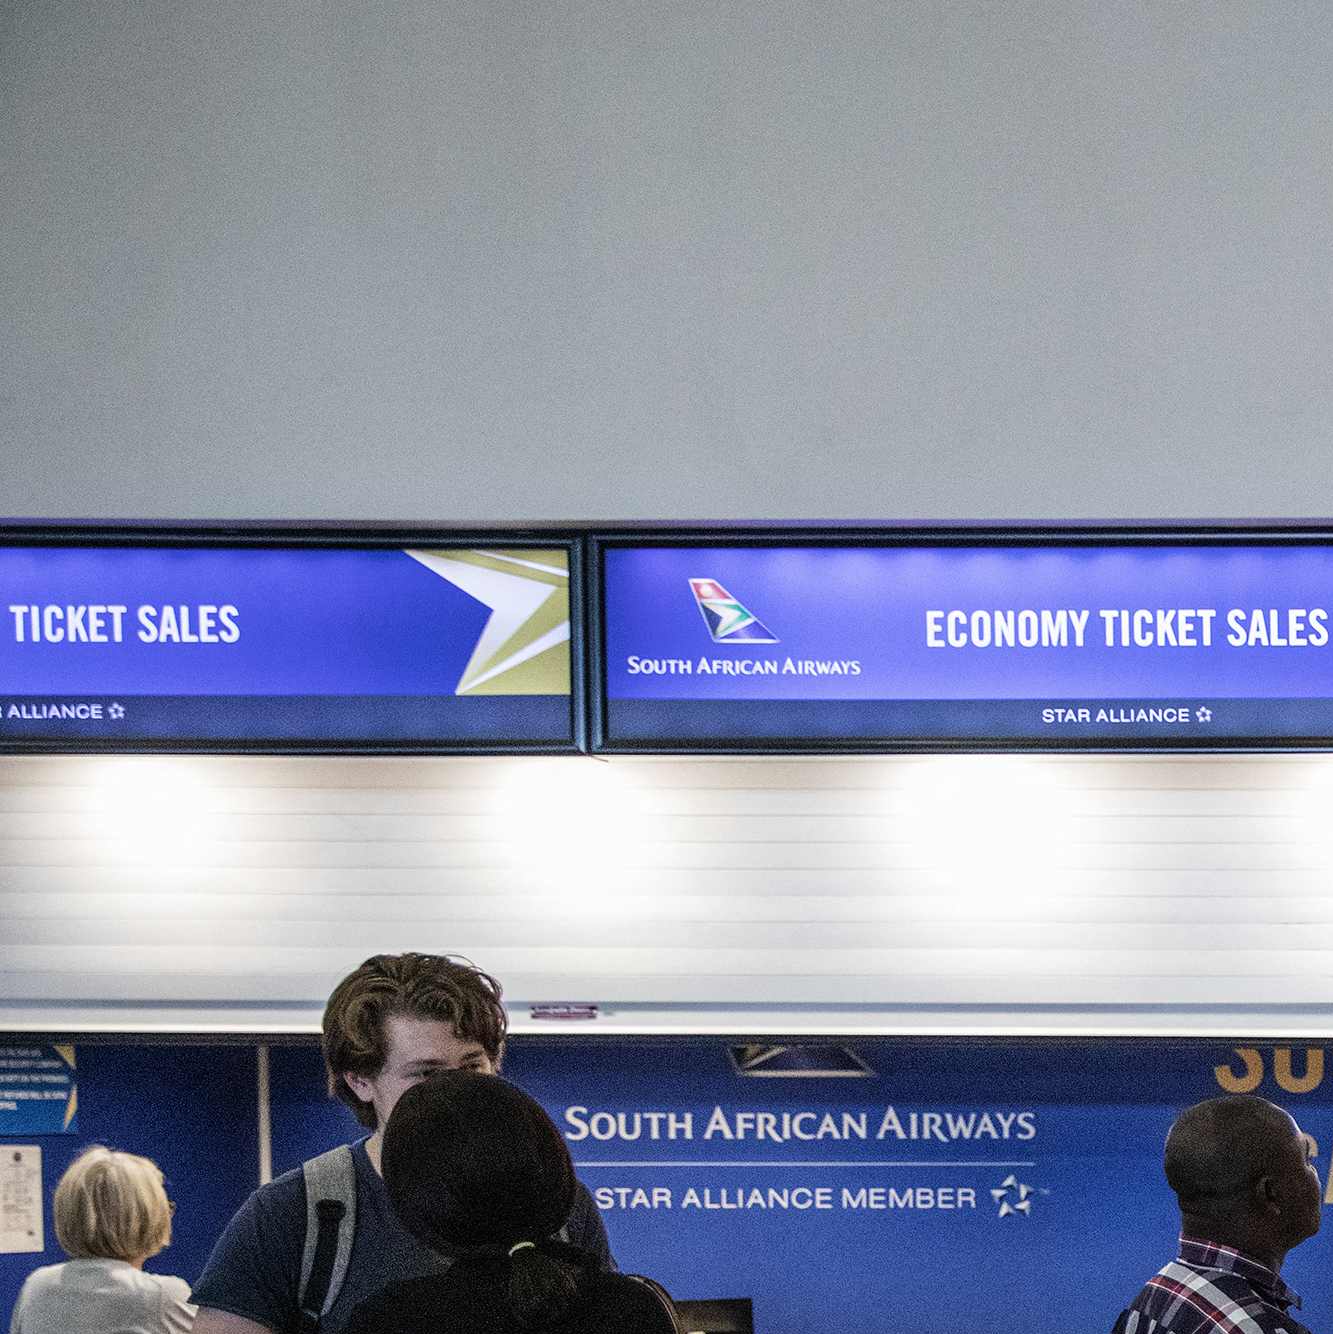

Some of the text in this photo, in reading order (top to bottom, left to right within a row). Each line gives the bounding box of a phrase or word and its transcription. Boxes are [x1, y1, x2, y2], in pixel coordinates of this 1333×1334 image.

[10, 605, 240, 643] TICKET SALES
[926, 609, 1329, 647] ECONOMY TICKET SALES
[628, 656, 861, 676] SOUTH AFRICAN AIRWAYS
[7, 704, 103, 719] ALLIANCE
[1042, 708, 1190, 723] STAR ALLIANCE
[564, 1106, 1036, 1143] SOUTH AFRICAN AIRWAYS
[595, 1187, 976, 1210] STAR ALLIANCE MEMBER
